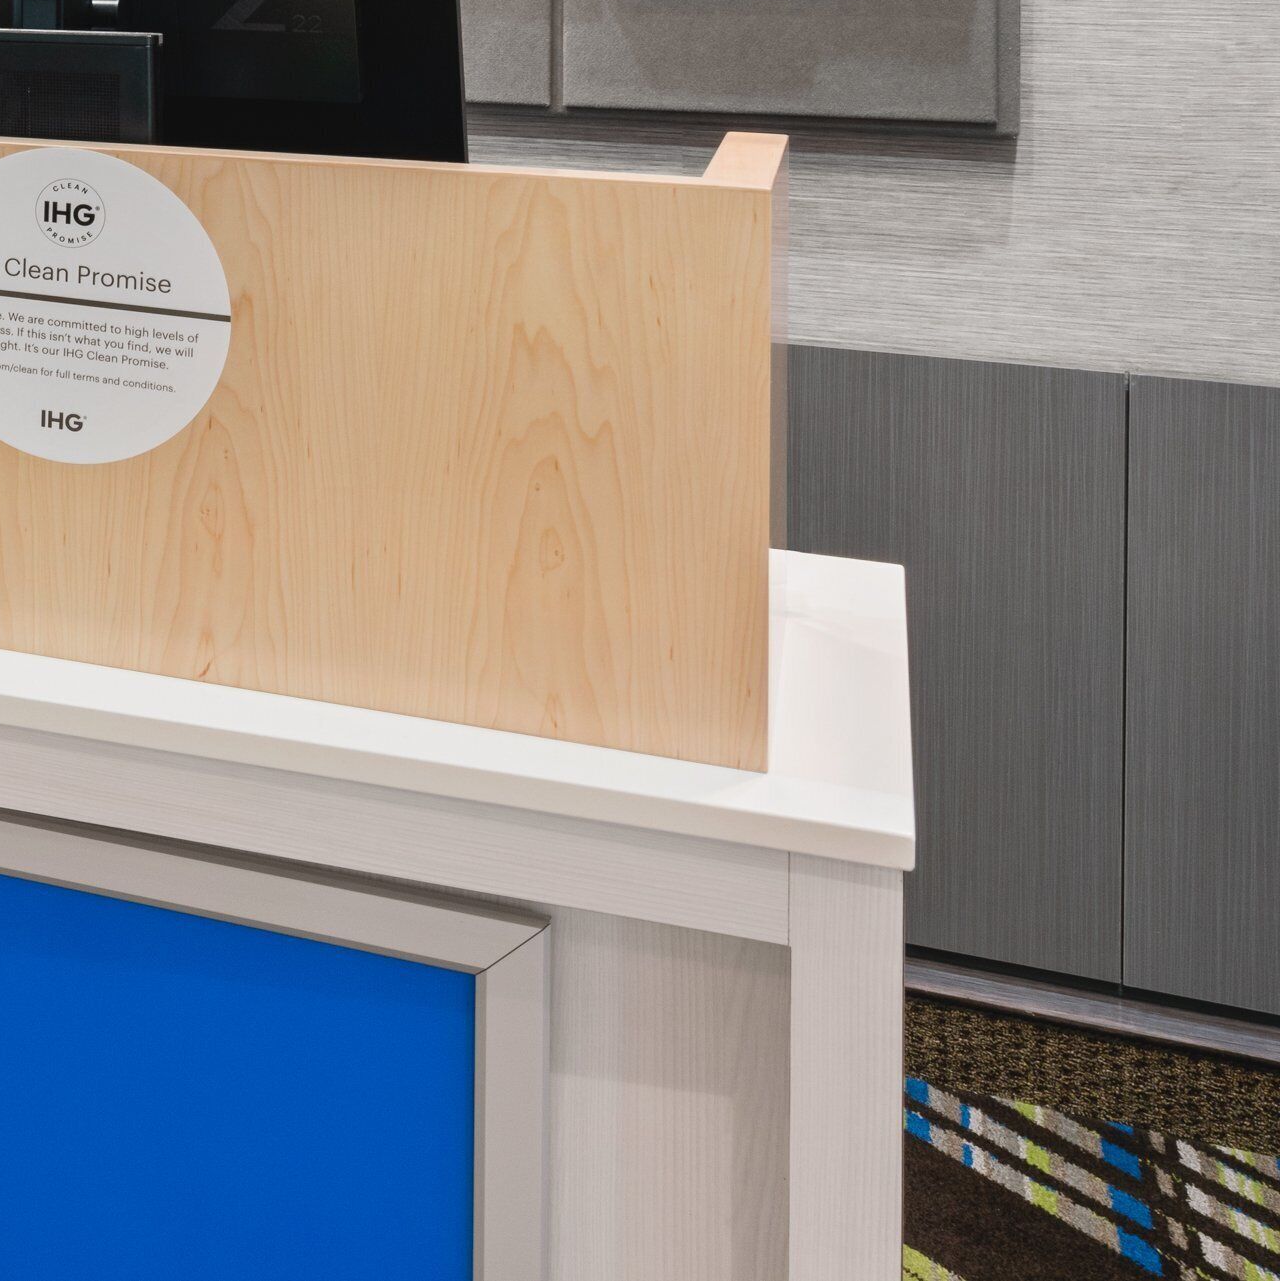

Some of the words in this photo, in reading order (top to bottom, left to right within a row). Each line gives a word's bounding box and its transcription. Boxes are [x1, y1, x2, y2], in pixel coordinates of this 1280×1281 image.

[52, 183, 89, 194] CLEAN
[44, 201, 96, 226] IHG
[46, 227, 93, 244] PROMISE
[4, 257, 69, 283] Clean
[77, 265, 172, 294] Promise
[8, 312, 25, 323] We
[27, 317, 45, 325] are
[47, 318, 107, 333] committed
[110, 325, 122, 335] to
[124, 325, 149, 339] high
[152, 328, 184, 342] levels
[187, 333, 199, 343] of
[17, 327, 25, 337] If
[27, 329, 47, 340] this
[49, 332, 71, 343] isn't
[74, 335, 101, 347] what
[104, 340, 124, 350] you
[127, 340, 152, 354] find,
[155, 346, 171, 355] we
[175, 347, 194, 358] will
[24, 343, 39, 353] It's
[41, 347, 60, 356] our
[63, 348, 84, 359] IHG
[86, 350, 118, 364] Clean
[121, 354, 169, 370] Promise.
[40, 367, 54, 377] for
[56, 369, 71, 380] full
[73, 372, 100, 383] terms
[102, 376, 120, 386] and
[122, 379, 176, 393] conditions.
[40, 409, 83, 432] IHG
